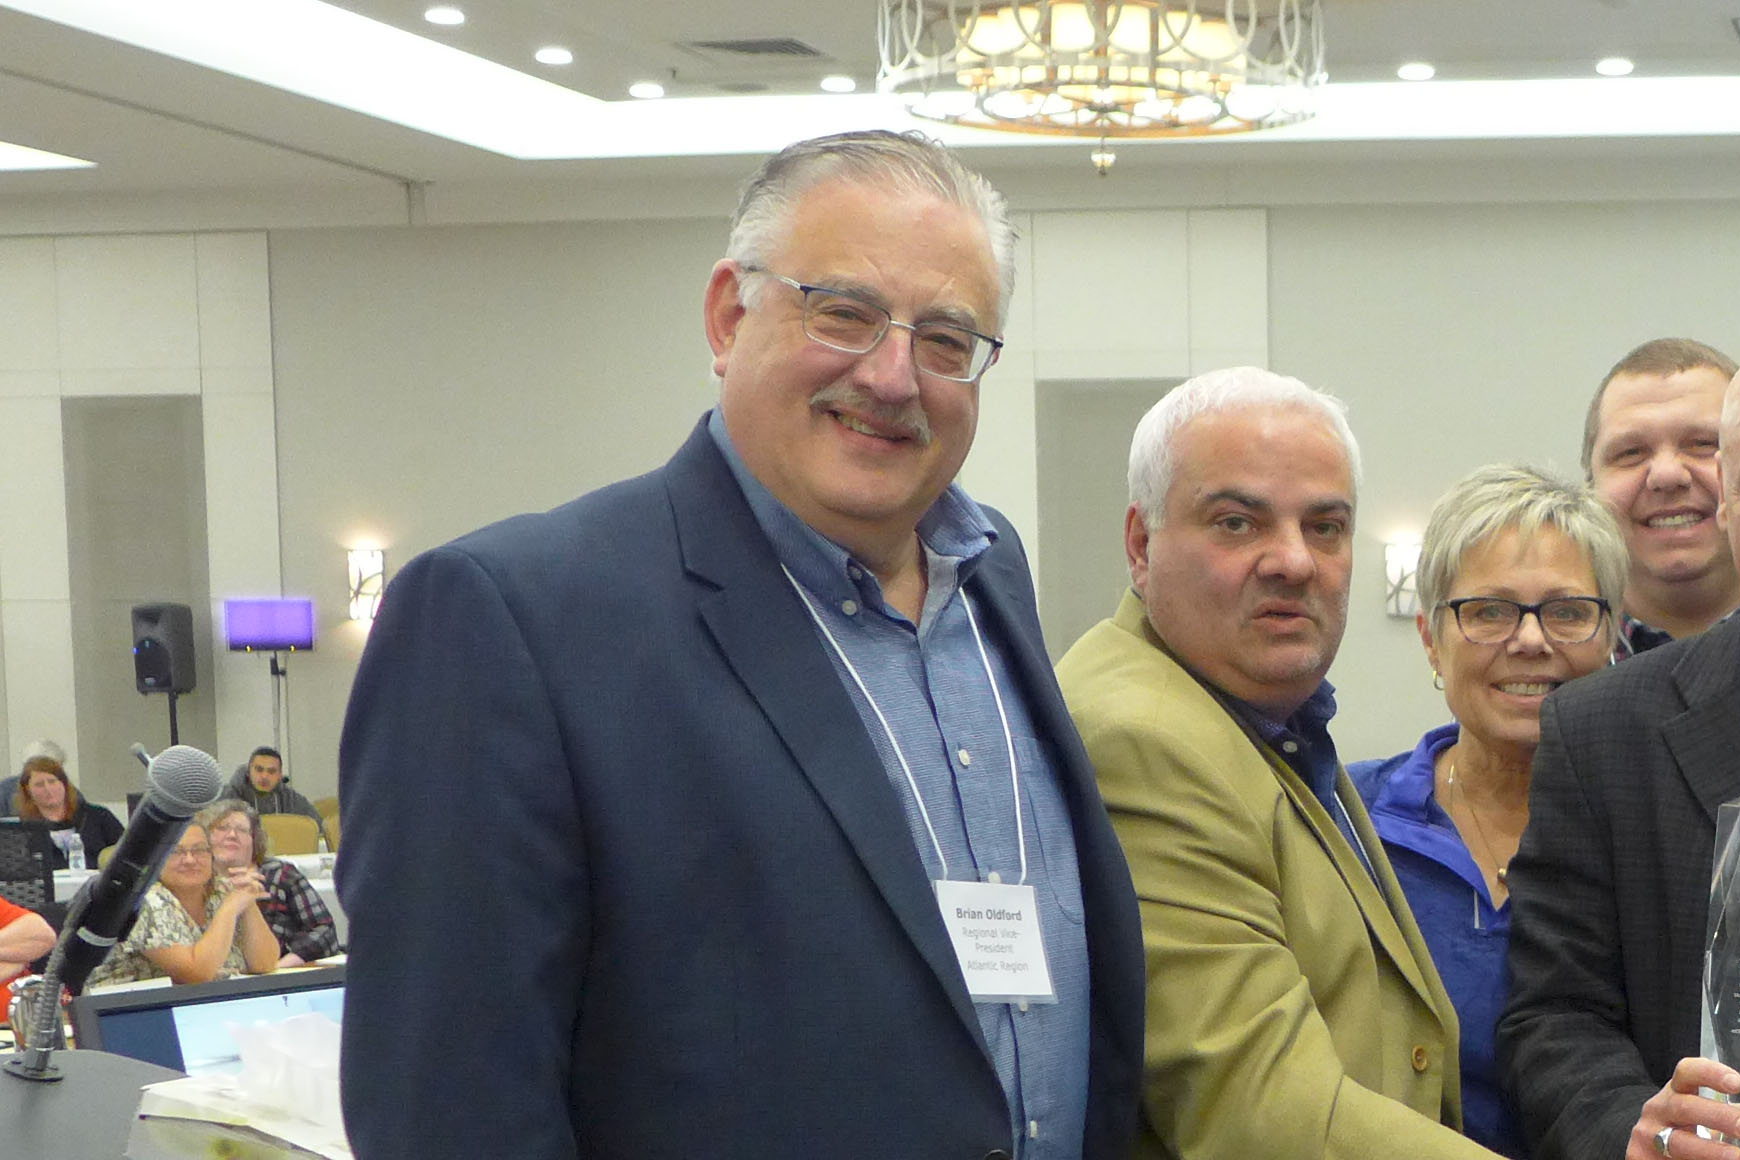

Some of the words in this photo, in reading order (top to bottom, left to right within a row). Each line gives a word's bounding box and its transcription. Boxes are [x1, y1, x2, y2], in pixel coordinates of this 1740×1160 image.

[956, 908, 983, 920] Brian
[986, 909, 1022, 921] Oldford
[962, 927, 997, 940] Regional
[975, 942, 1014, 953] President
[967, 960, 999, 971] Atlantic
[1000, 960, 1029, 973] Region
